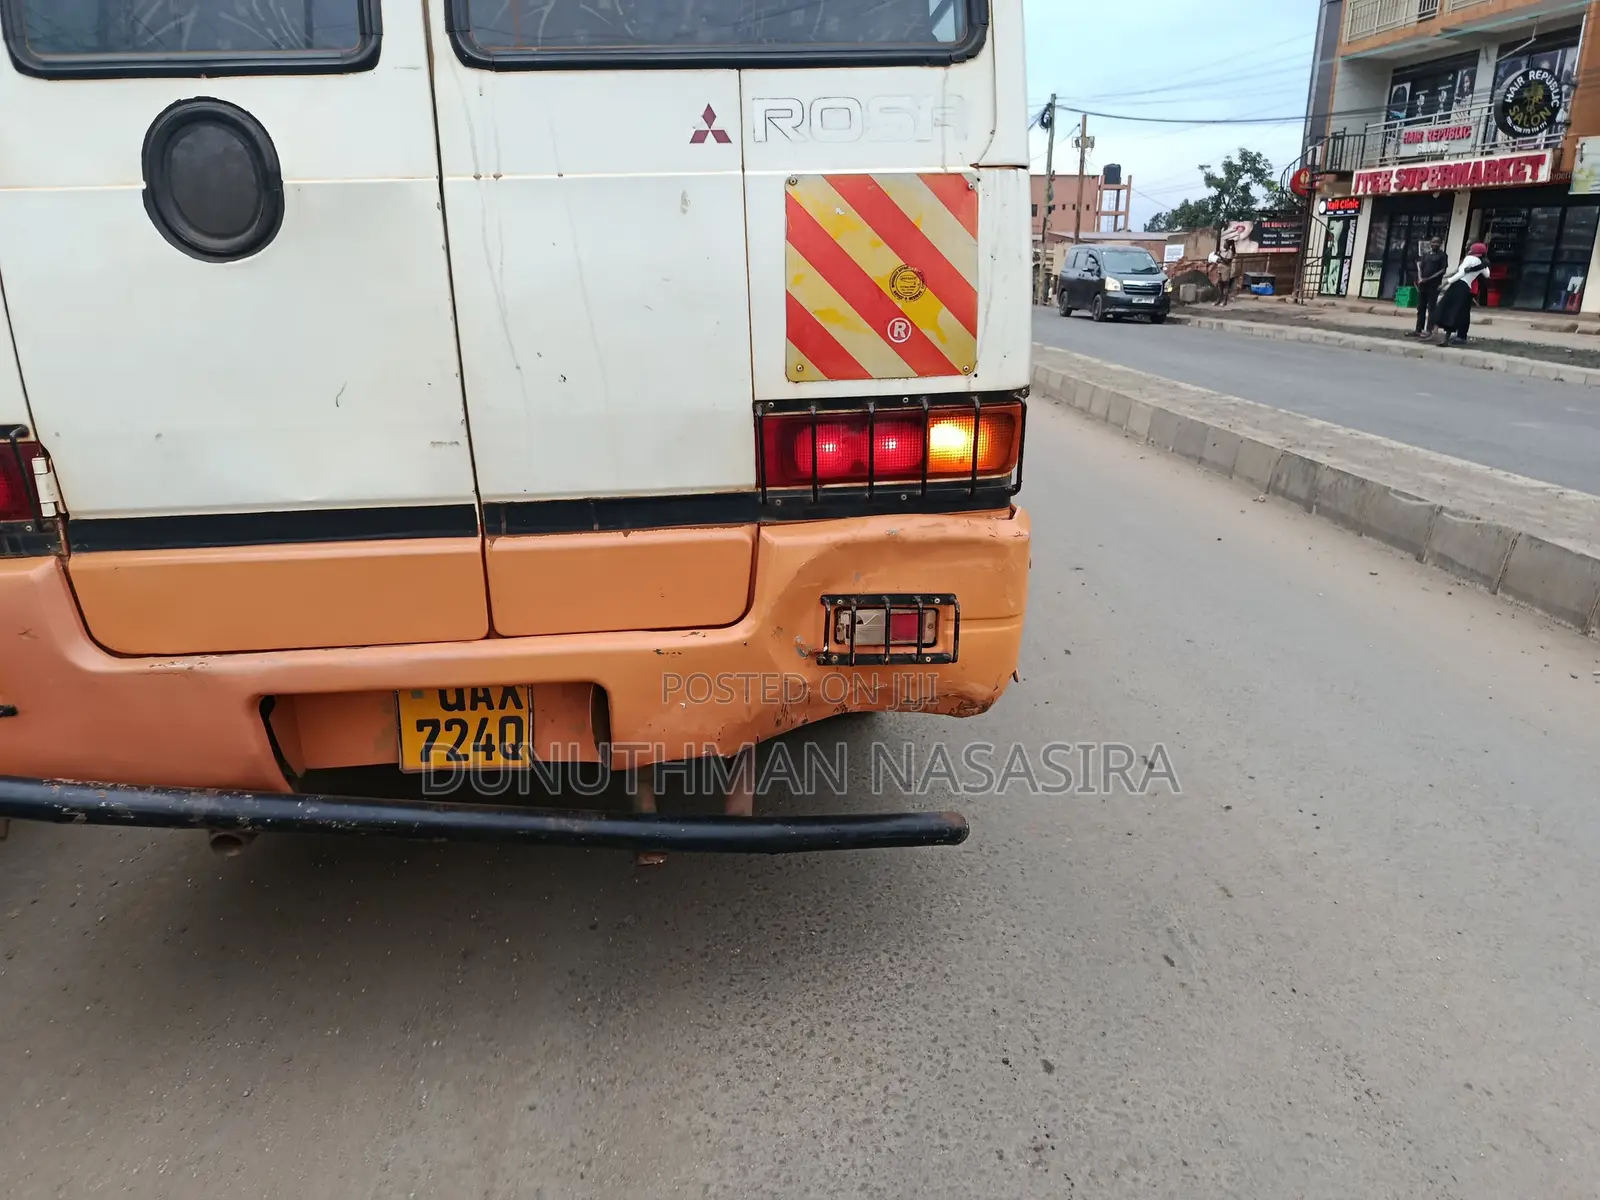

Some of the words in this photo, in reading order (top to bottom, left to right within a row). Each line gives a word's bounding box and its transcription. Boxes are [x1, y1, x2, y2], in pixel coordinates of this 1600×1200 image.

[1505, 76, 1526, 103] HAIR
[1528, 70, 1561, 108] REPUBLIC
[1509, 105, 1552, 127] SALON
[1403, 131, 1425, 145] HAIR
[1428, 125, 1472, 143] REPUBLIC
[1394, 153, 1546, 191] SUPERMARKET
[1339, 197, 1359, 209] Clinic
[416, 715, 524, 762] 724Q
